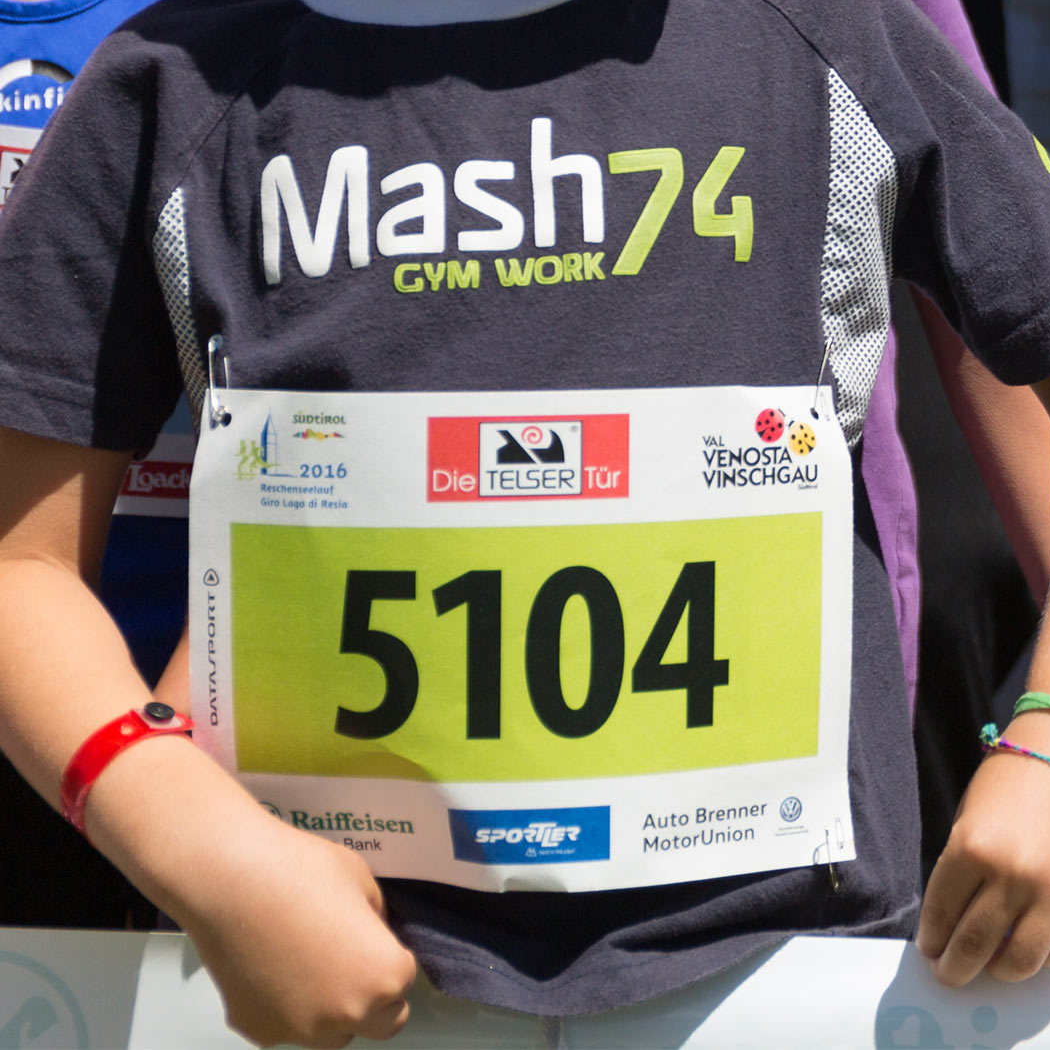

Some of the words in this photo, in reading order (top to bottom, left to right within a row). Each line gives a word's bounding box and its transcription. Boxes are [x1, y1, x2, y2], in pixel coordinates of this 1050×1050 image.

[260, 116, 755, 286] Mash74
[393, 259, 481, 293] GYM
[494, 251, 606, 287] WORK
[702, 435, 725, 447] VAL
[703, 446, 793, 468] VENOSTA
[299, 462, 348, 479] 2016
[432, 469, 476, 492] Die
[486, 468, 576, 490] TELSER
[584, 466, 621, 489] Tür
[703, 464, 818, 489] VINSCHGAU
[260, 483, 335, 496] Reschenseelauf
[260, 497, 280, 508] Giro
[282, 498, 306, 510] Lago
[308, 499, 318, 509] di
[320, 499, 348, 510] Resia
[207, 591, 219, 727] DATASPORT
[334, 560, 730, 741] 5104
[290, 810, 415, 834] Raiffeisen
[642, 813, 690, 830] Auto
[696, 803, 768, 824] Brenner
[474, 821, 581, 848] SPORTLER
[643, 826, 755, 853] MotorUnion
